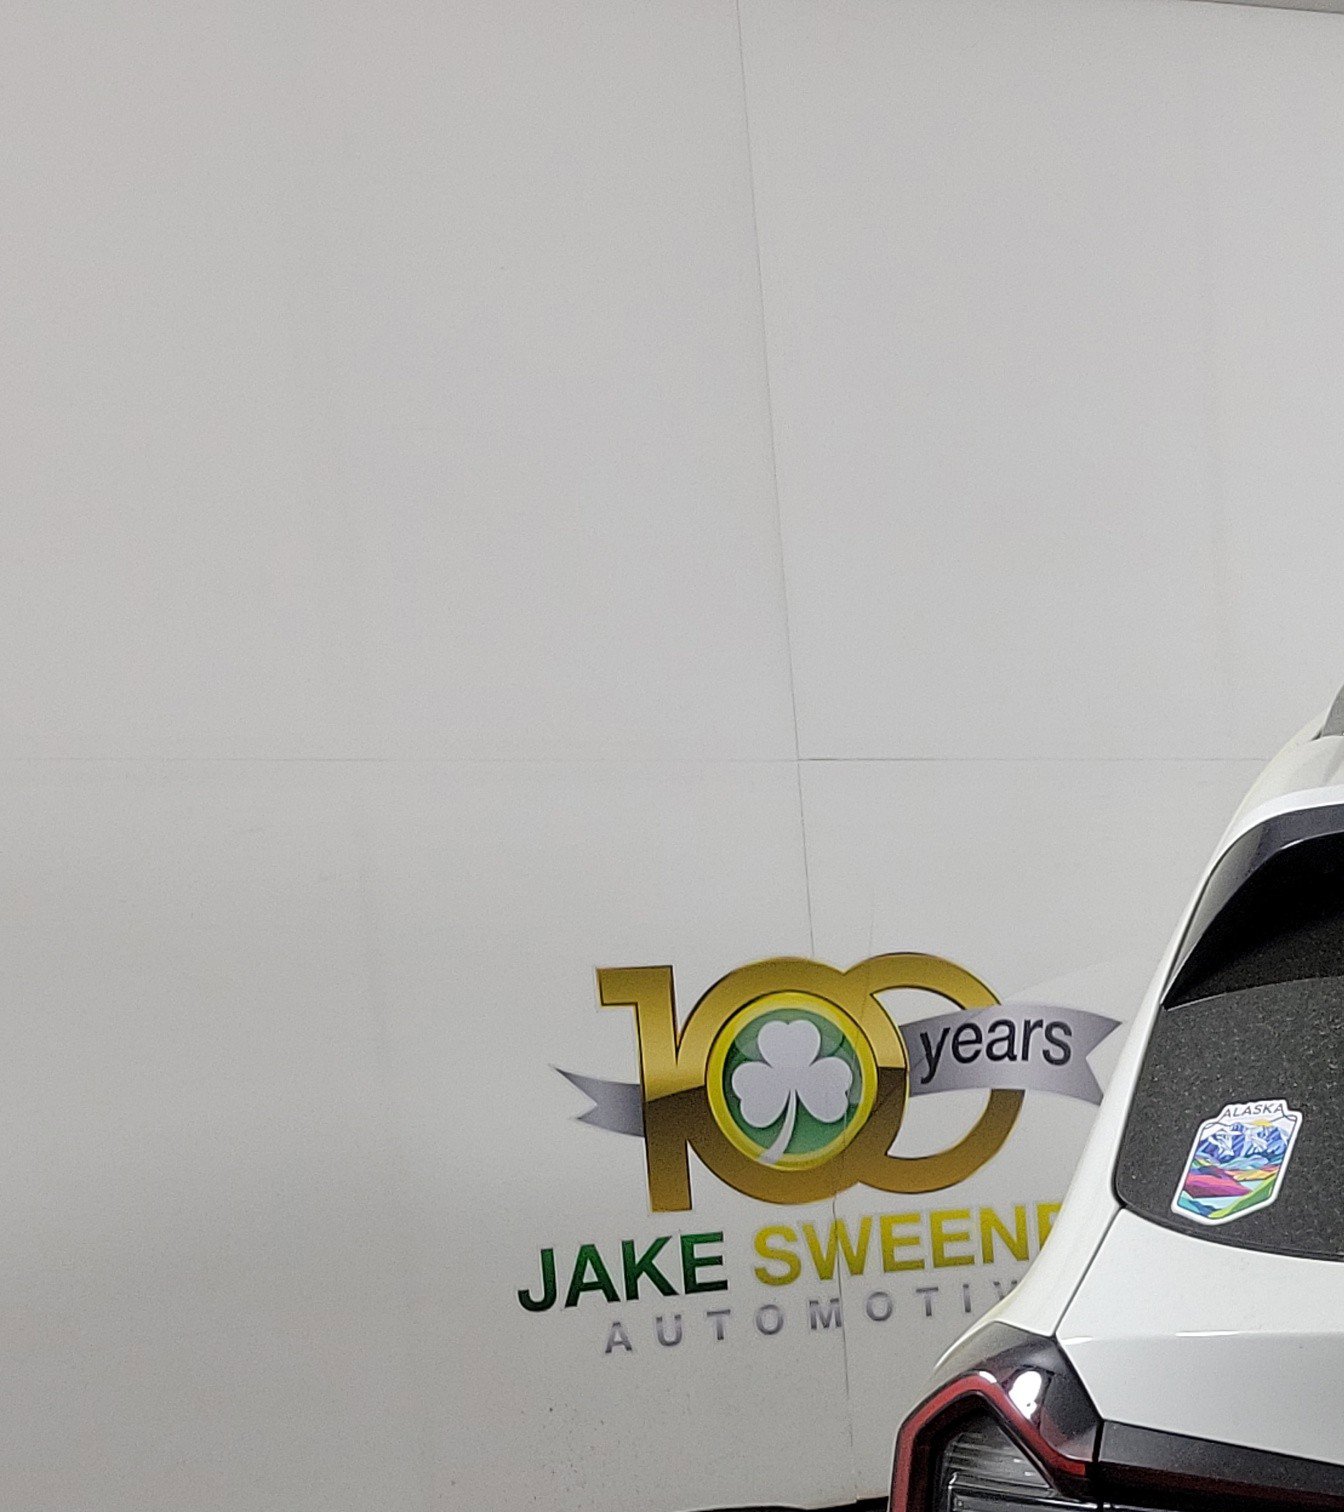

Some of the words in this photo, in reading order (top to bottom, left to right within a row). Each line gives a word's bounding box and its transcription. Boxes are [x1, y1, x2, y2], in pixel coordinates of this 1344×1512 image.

[596, 952, 1025, 1213] 100
[919, 1018, 1073, 1075] years
[1222, 1103, 1284, 1118] ALASKA
[517, 1230, 729, 1314] JAKE
[753, 1202, 1063, 1287] SWEEN
